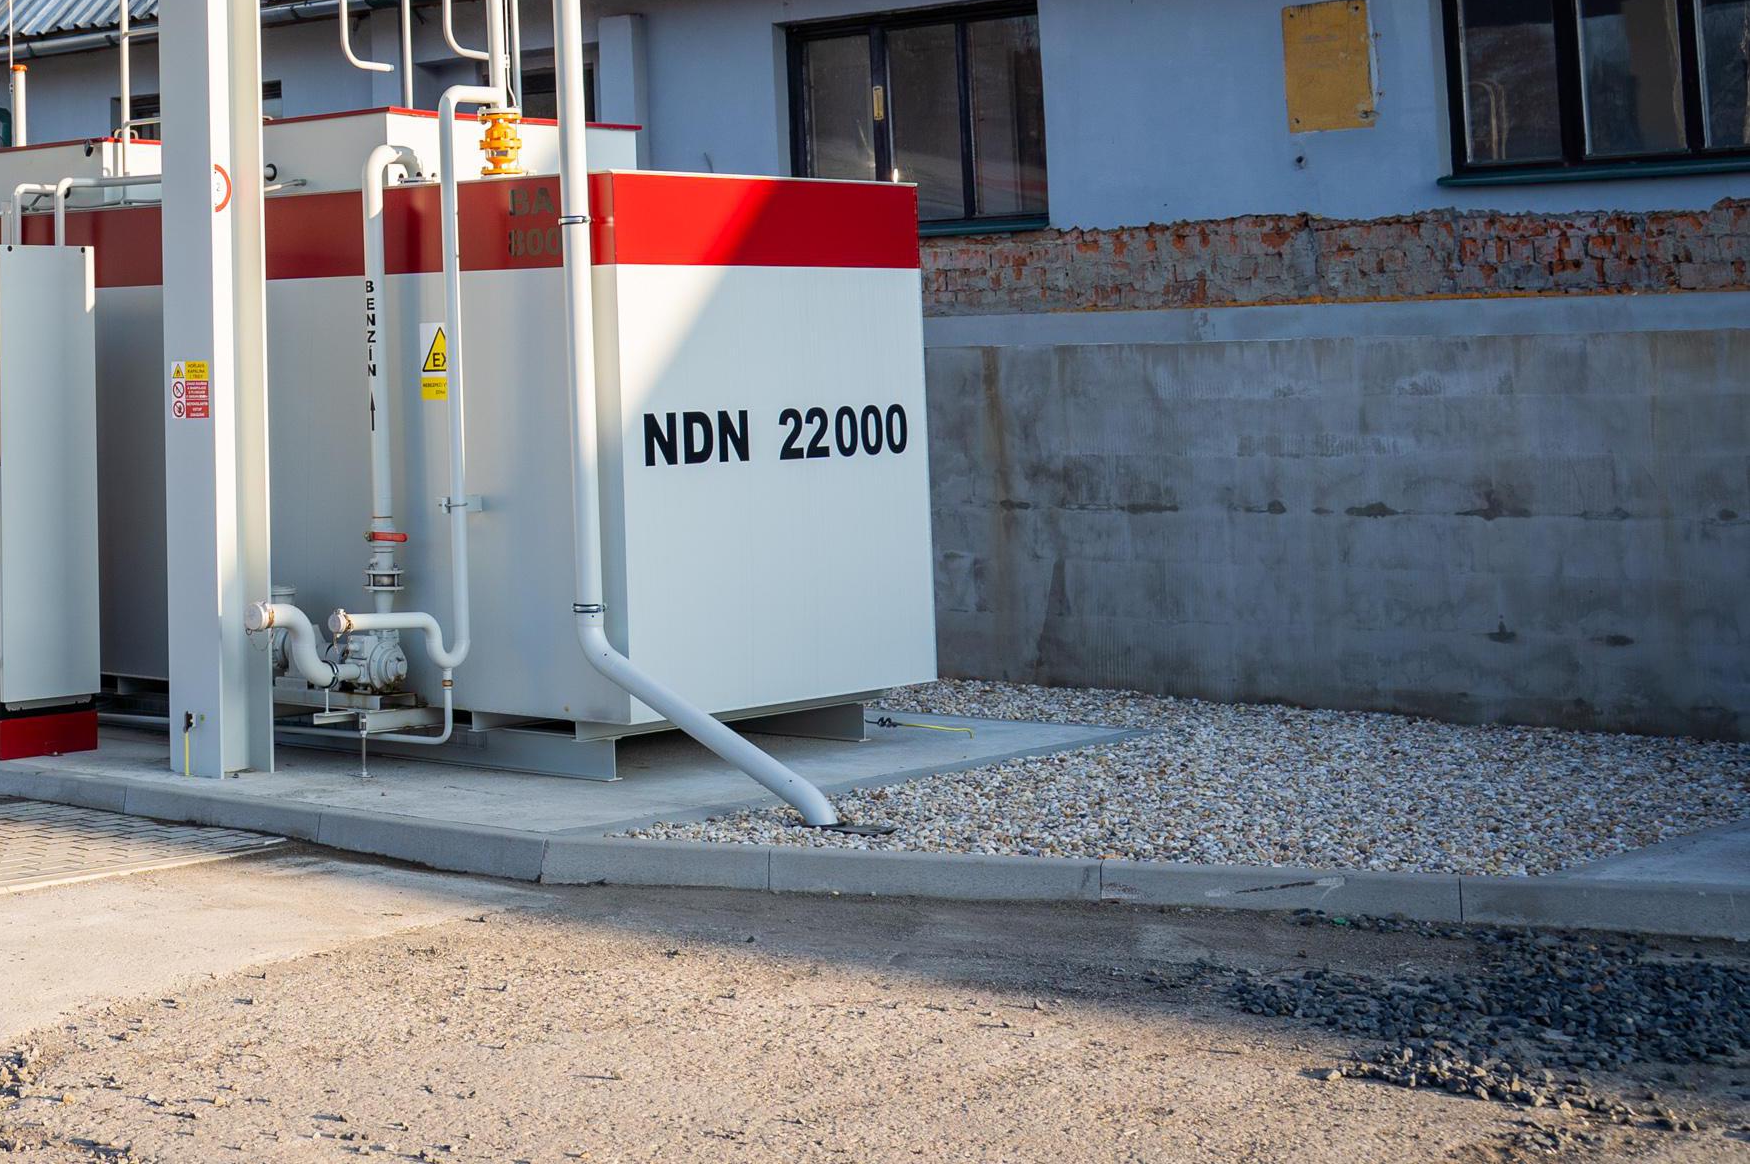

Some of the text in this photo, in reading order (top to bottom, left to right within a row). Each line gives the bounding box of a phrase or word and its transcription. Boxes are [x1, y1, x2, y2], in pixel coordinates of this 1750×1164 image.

[508, 186, 555, 215] BA
[365, 280, 376, 377] BENZÍN
[643, 403, 908, 467] NDN 22000
